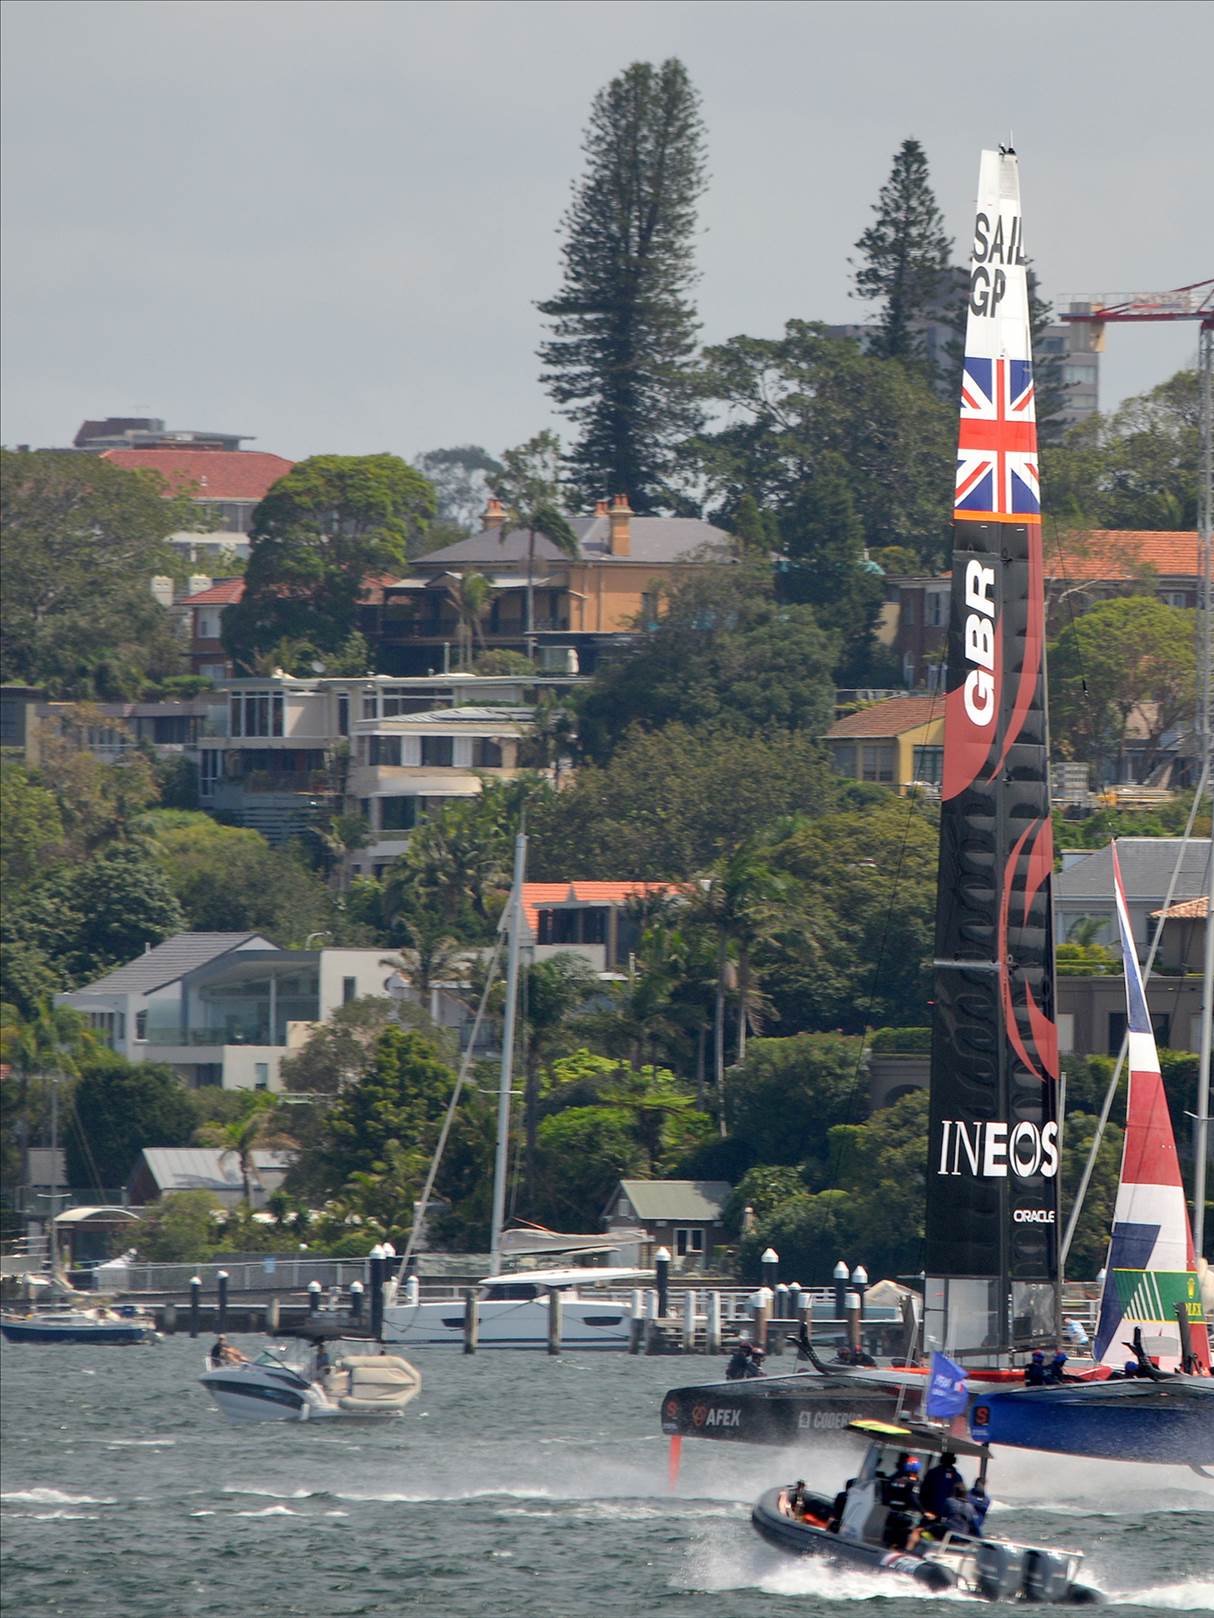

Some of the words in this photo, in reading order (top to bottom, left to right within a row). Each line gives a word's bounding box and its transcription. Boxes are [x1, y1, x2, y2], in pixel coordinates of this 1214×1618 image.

[973, 212, 1026, 266] SAIL
[969, 266, 1006, 318] GP
[964, 559, 995, 727] GBR
[937, 1121, 1058, 1178] INEOS
[1013, 1210, 1055, 1223] ORACLE
[705, 1408, 741, 1427] AFEX
